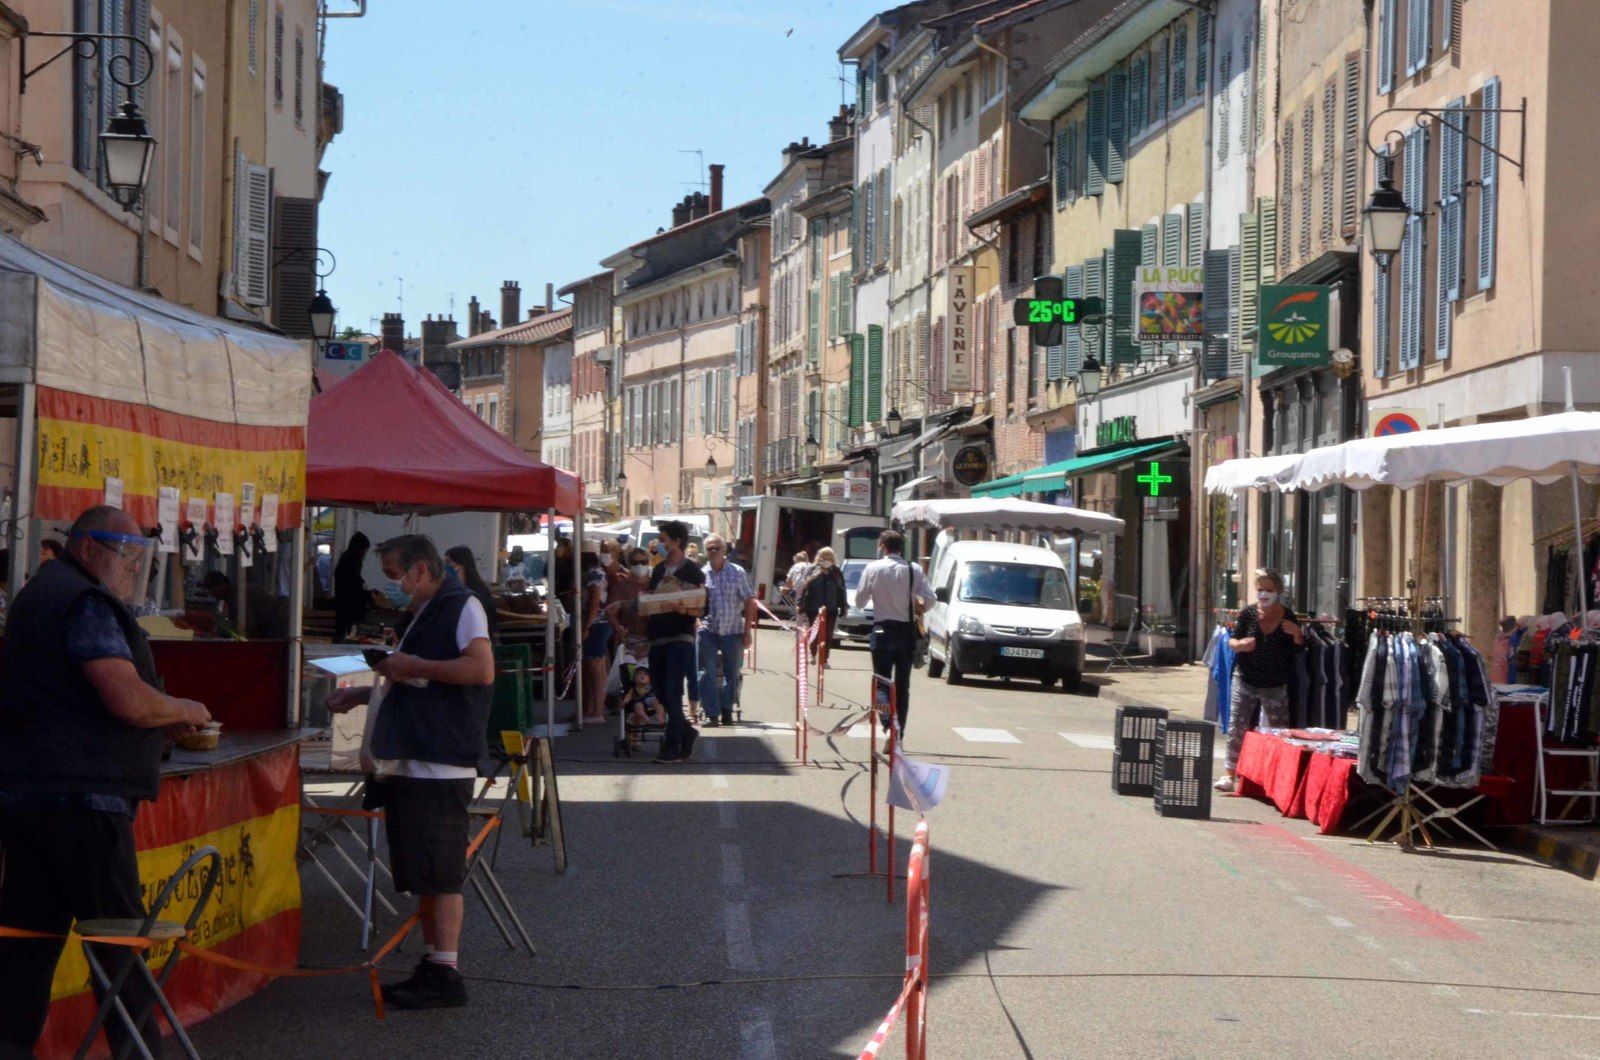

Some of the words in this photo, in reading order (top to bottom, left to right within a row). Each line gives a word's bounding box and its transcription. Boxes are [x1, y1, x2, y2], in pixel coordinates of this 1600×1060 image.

[1142, 267, 1162, 284] LA
[952, 274, 967, 364] TAVERNE
[1028, 300, 1075, 323] 25°C
[1267, 349, 1321, 359] Groupama
